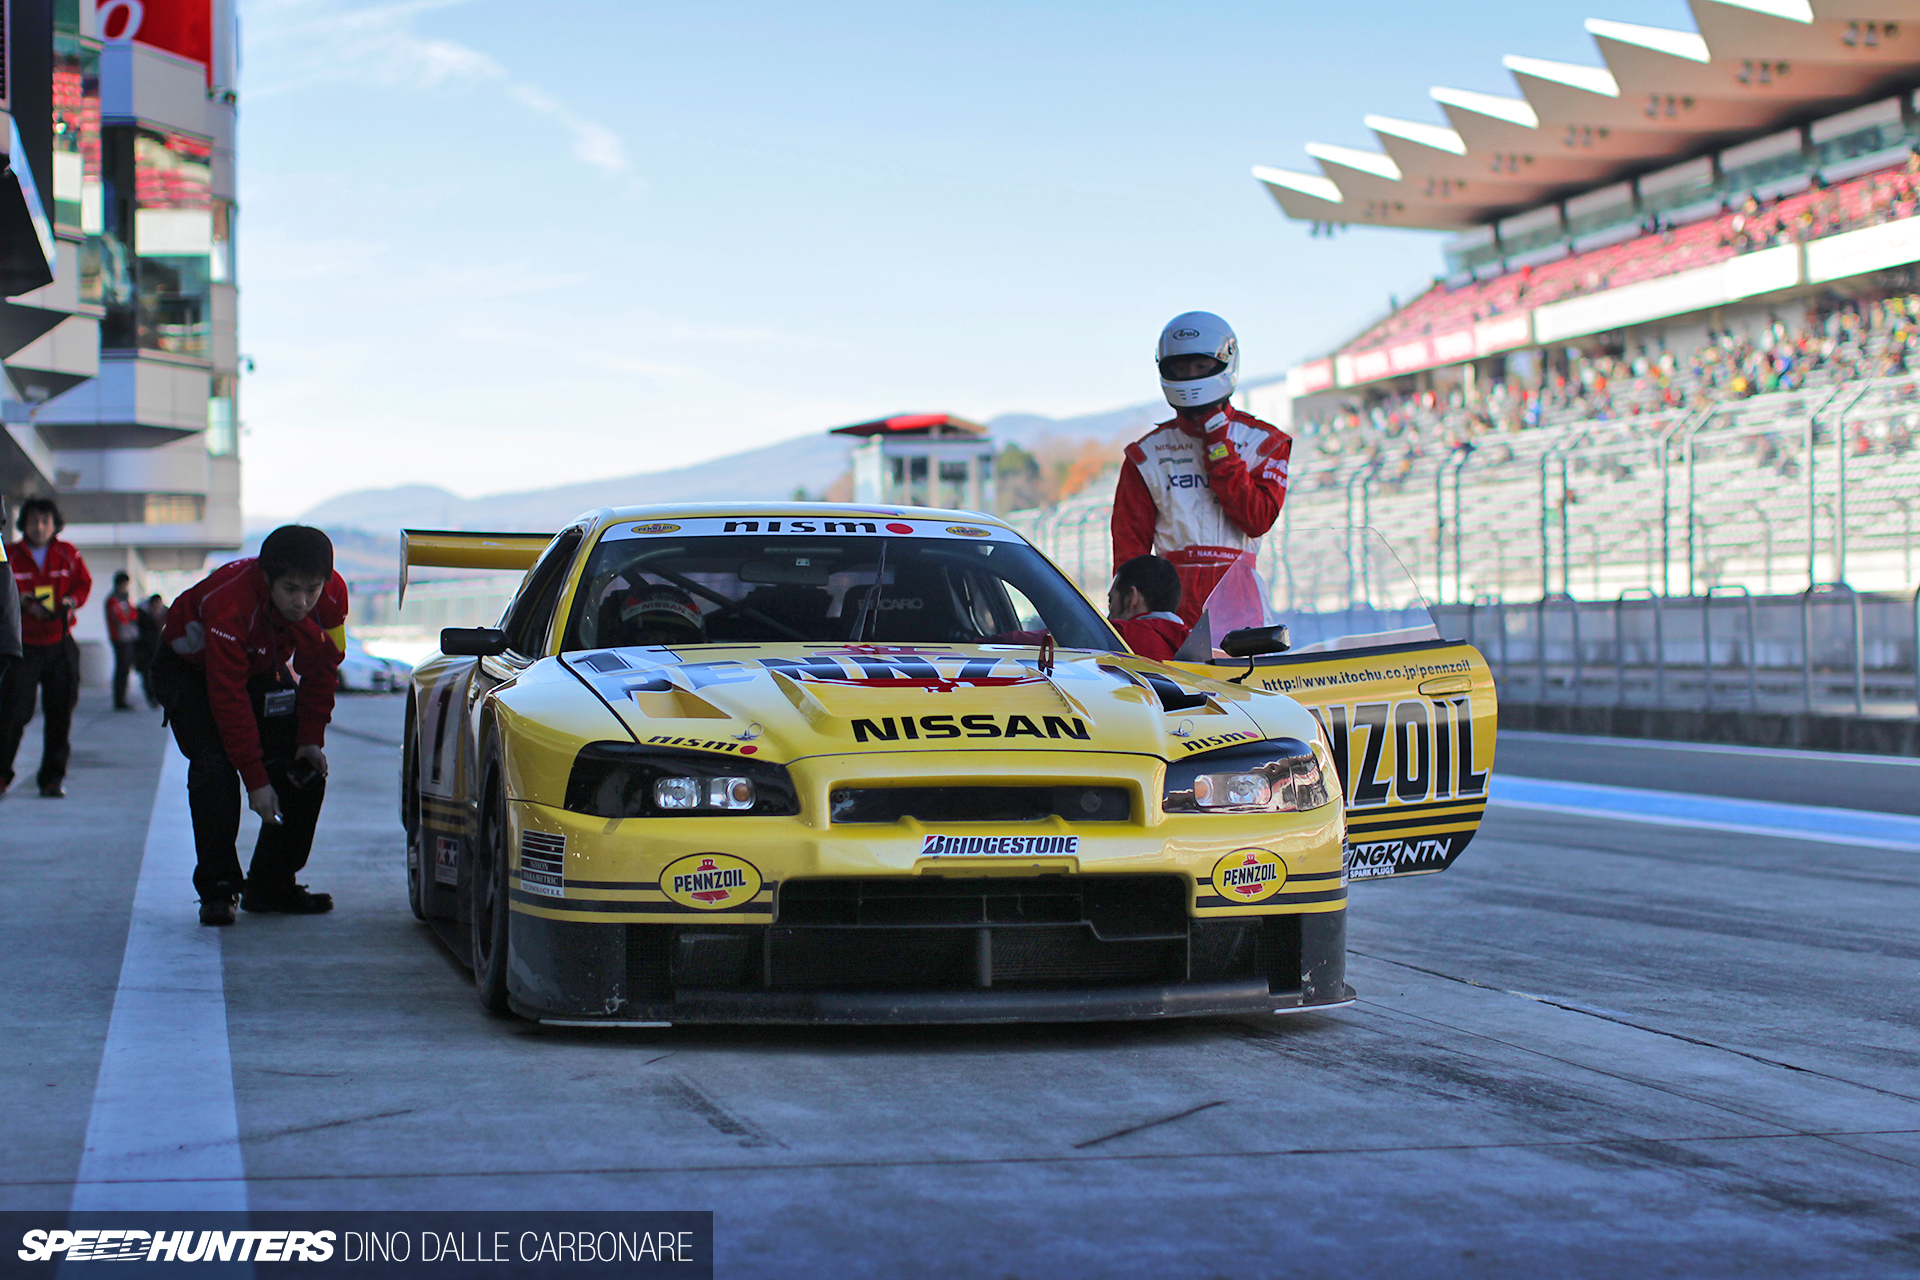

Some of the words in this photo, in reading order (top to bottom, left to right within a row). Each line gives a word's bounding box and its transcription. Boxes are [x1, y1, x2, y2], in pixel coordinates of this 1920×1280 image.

[1177, 329, 1196, 337] Arai
[1154, 443, 1194, 453] NISSAN
[723, 521, 914, 534] nismo
[1197, 550, 1235, 559] NAKAJIMA
[642, 602, 686, 614] NISSAN
[1262, 659, 1472, 692] http://www.itochu.co.jp/pennzoil
[851, 714, 1092, 743] NISSAN
[647, 735, 758, 755] nismo
[1181, 730, 1259, 752] nismo
[920, 835, 1078, 855] BRIDGESTONE
[1401, 838, 1452, 865] NTN
[1351, 842, 1402, 869] NGK
[673, 868, 747, 893] PENNZOIL
[1222, 863, 1278, 887] PENNZOIL
[1350, 869, 1372, 878] SPARK
[1372, 866, 1395, 875] PLUGS
